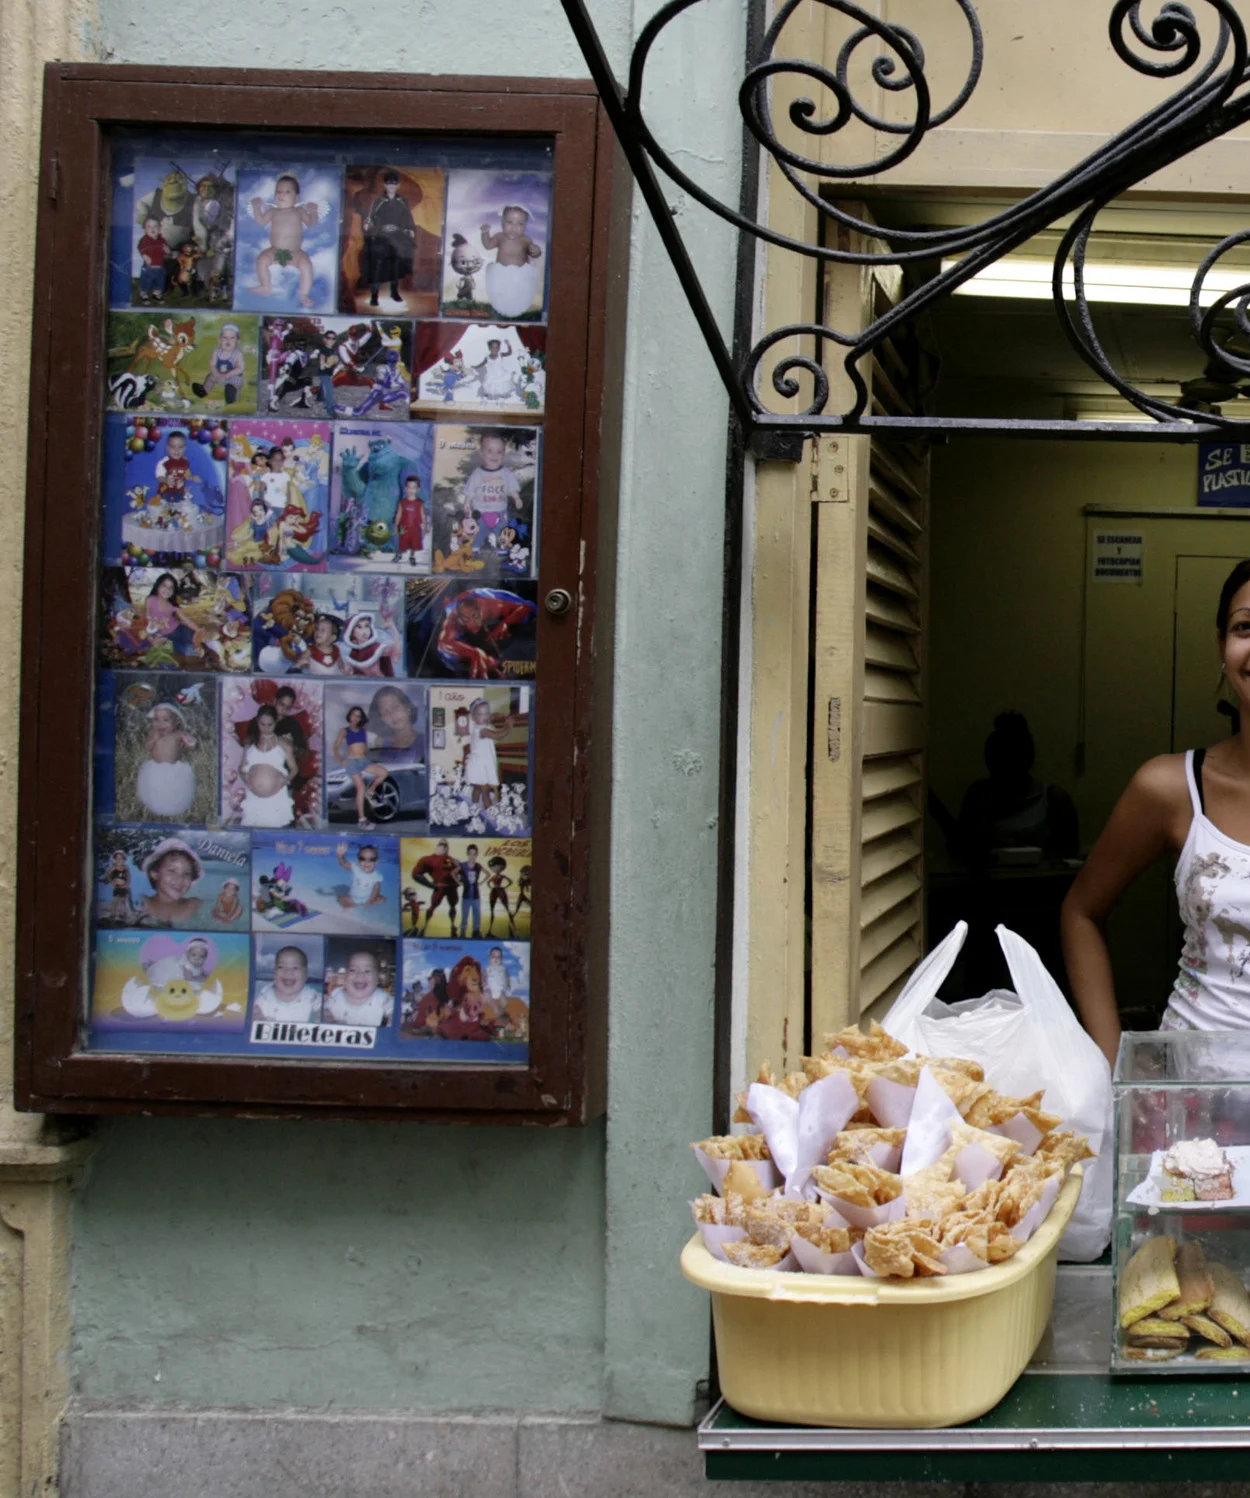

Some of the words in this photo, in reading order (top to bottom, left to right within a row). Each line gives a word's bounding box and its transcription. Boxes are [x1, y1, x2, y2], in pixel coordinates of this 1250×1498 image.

[1204, 448, 1233, 471] SE
[502, 660, 537, 675] SPIDERM
[199, 838, 247, 868] Daniela
[254, 1022, 373, 1046] Billeteras
